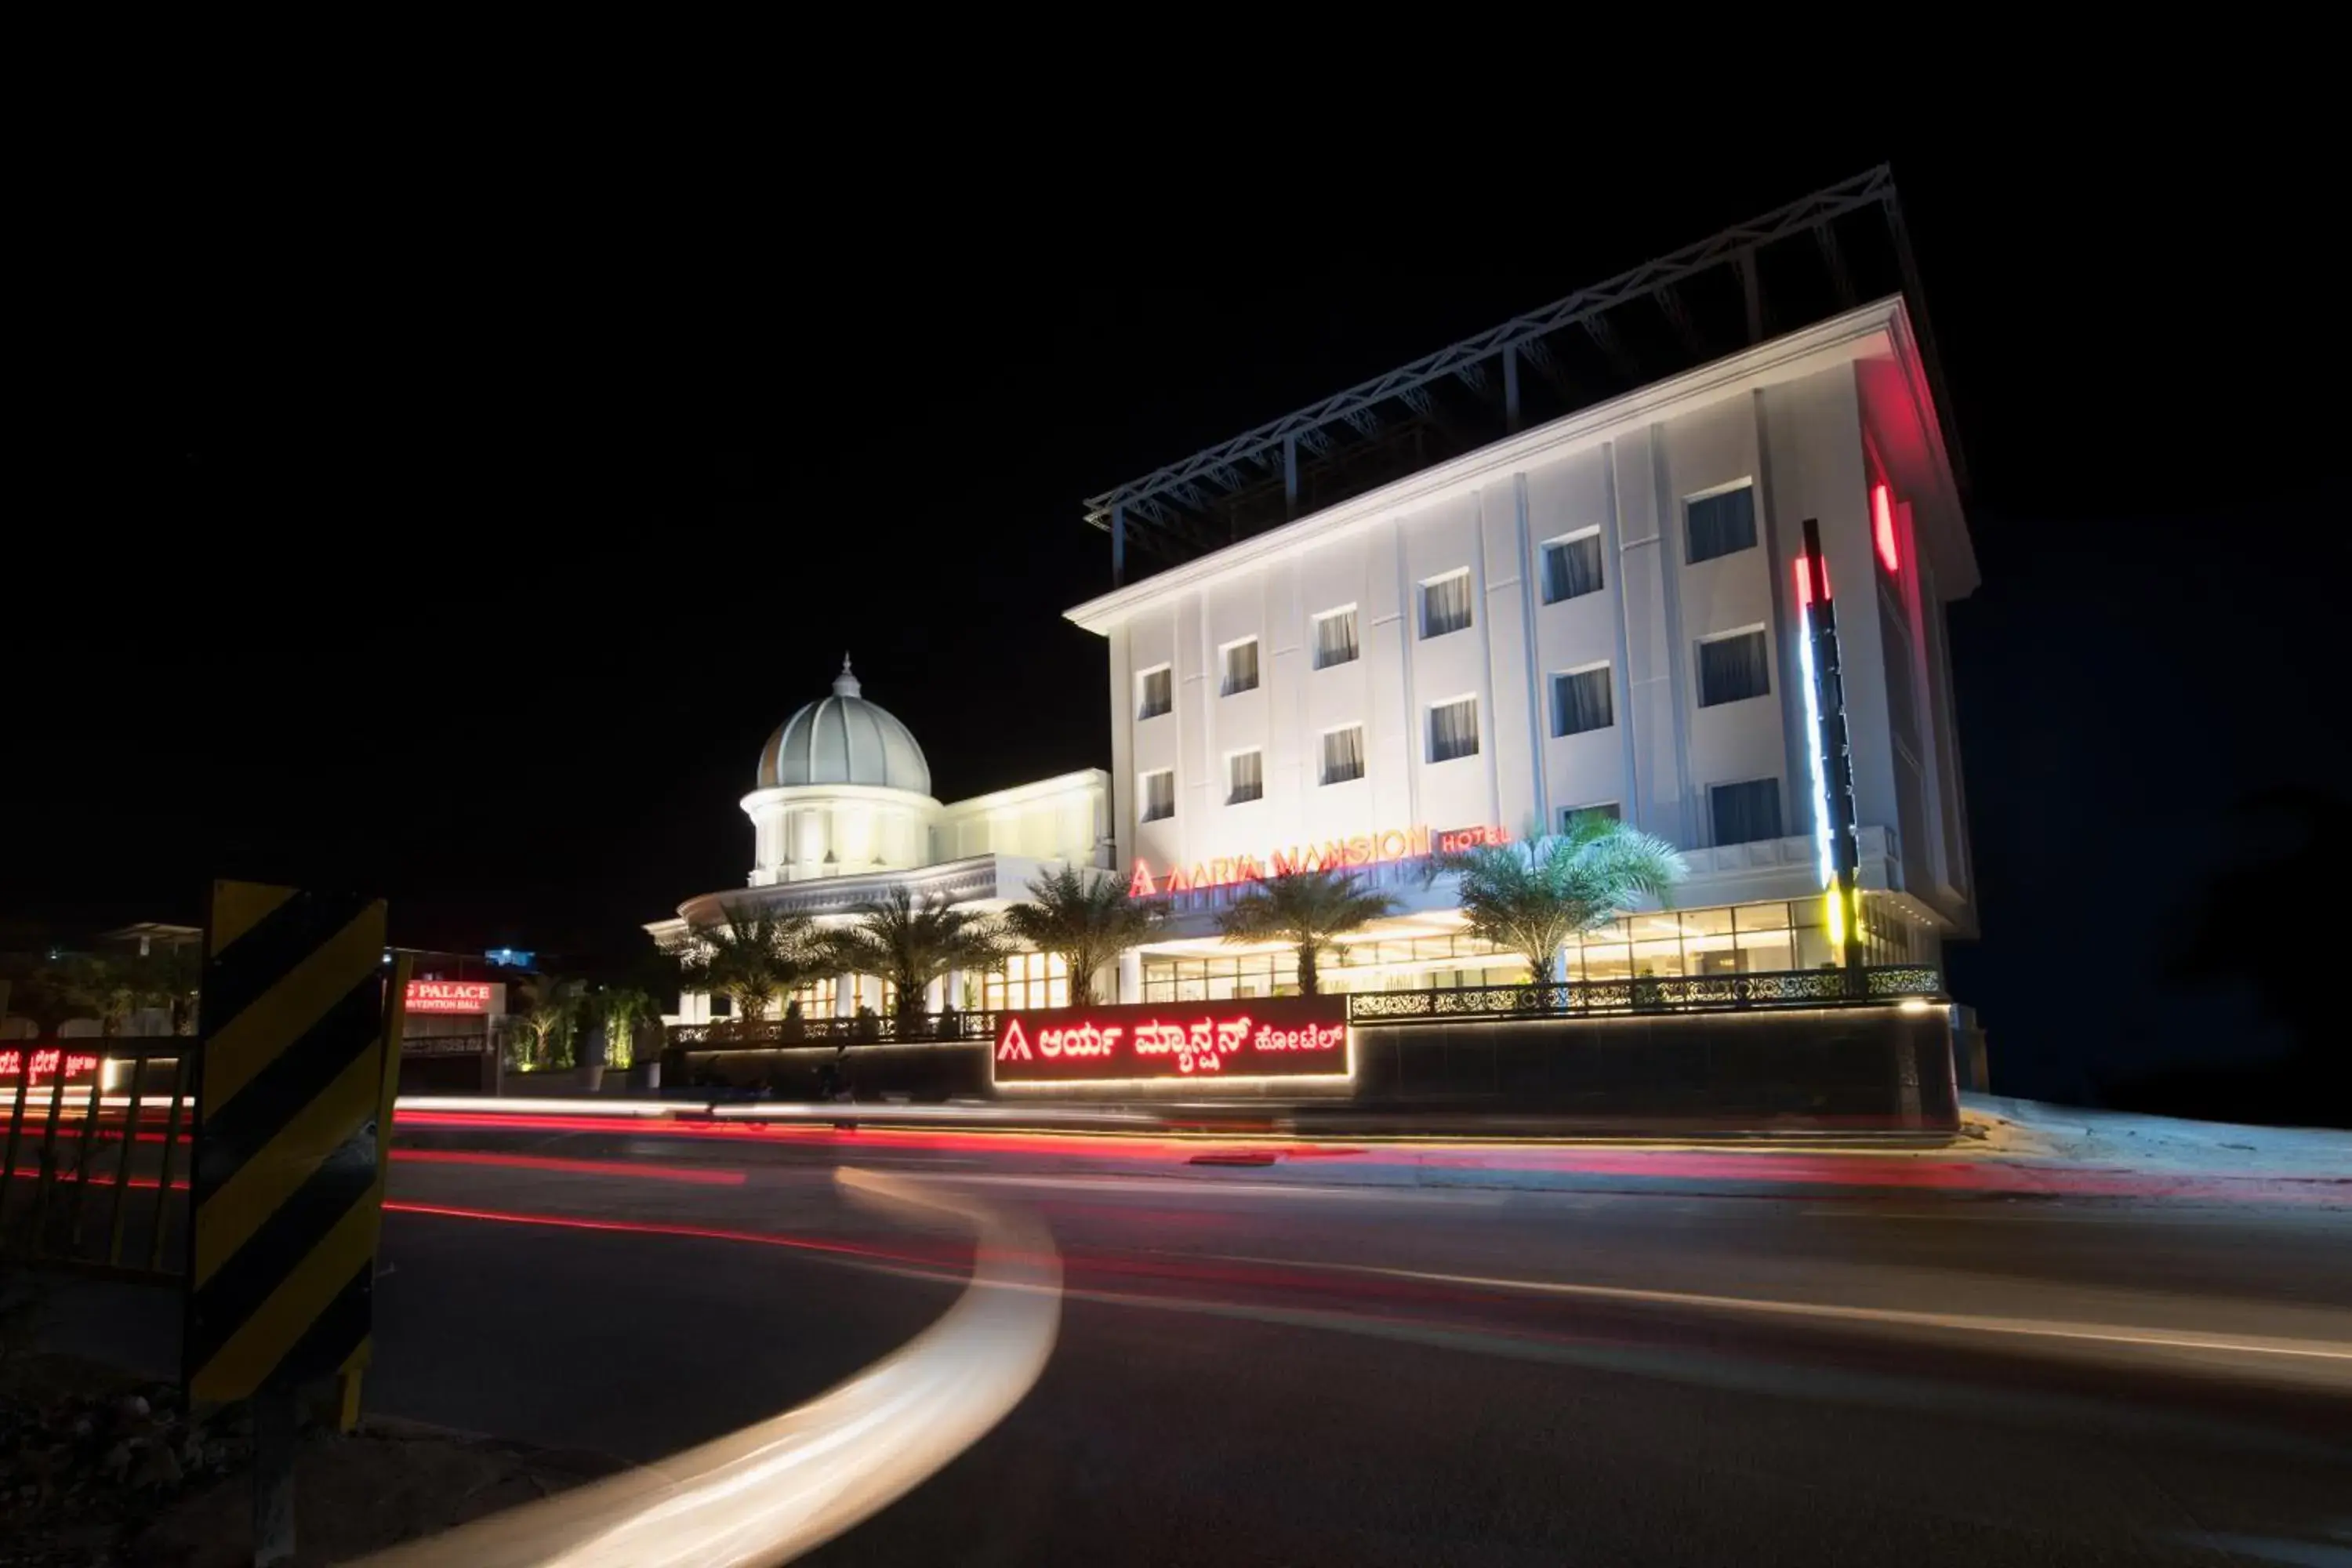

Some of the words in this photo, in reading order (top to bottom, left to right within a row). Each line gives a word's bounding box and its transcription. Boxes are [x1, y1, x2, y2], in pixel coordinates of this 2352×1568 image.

[1271, 825, 1432, 875] MANSION
[1443, 826, 1511, 852] HOTEL
[419, 984, 490, 999] PALACE
[1040, 1021, 1123, 1058] ಆರ್ಯ
[1254, 1023, 1344, 1051] ಹೋಟೆಲ್
